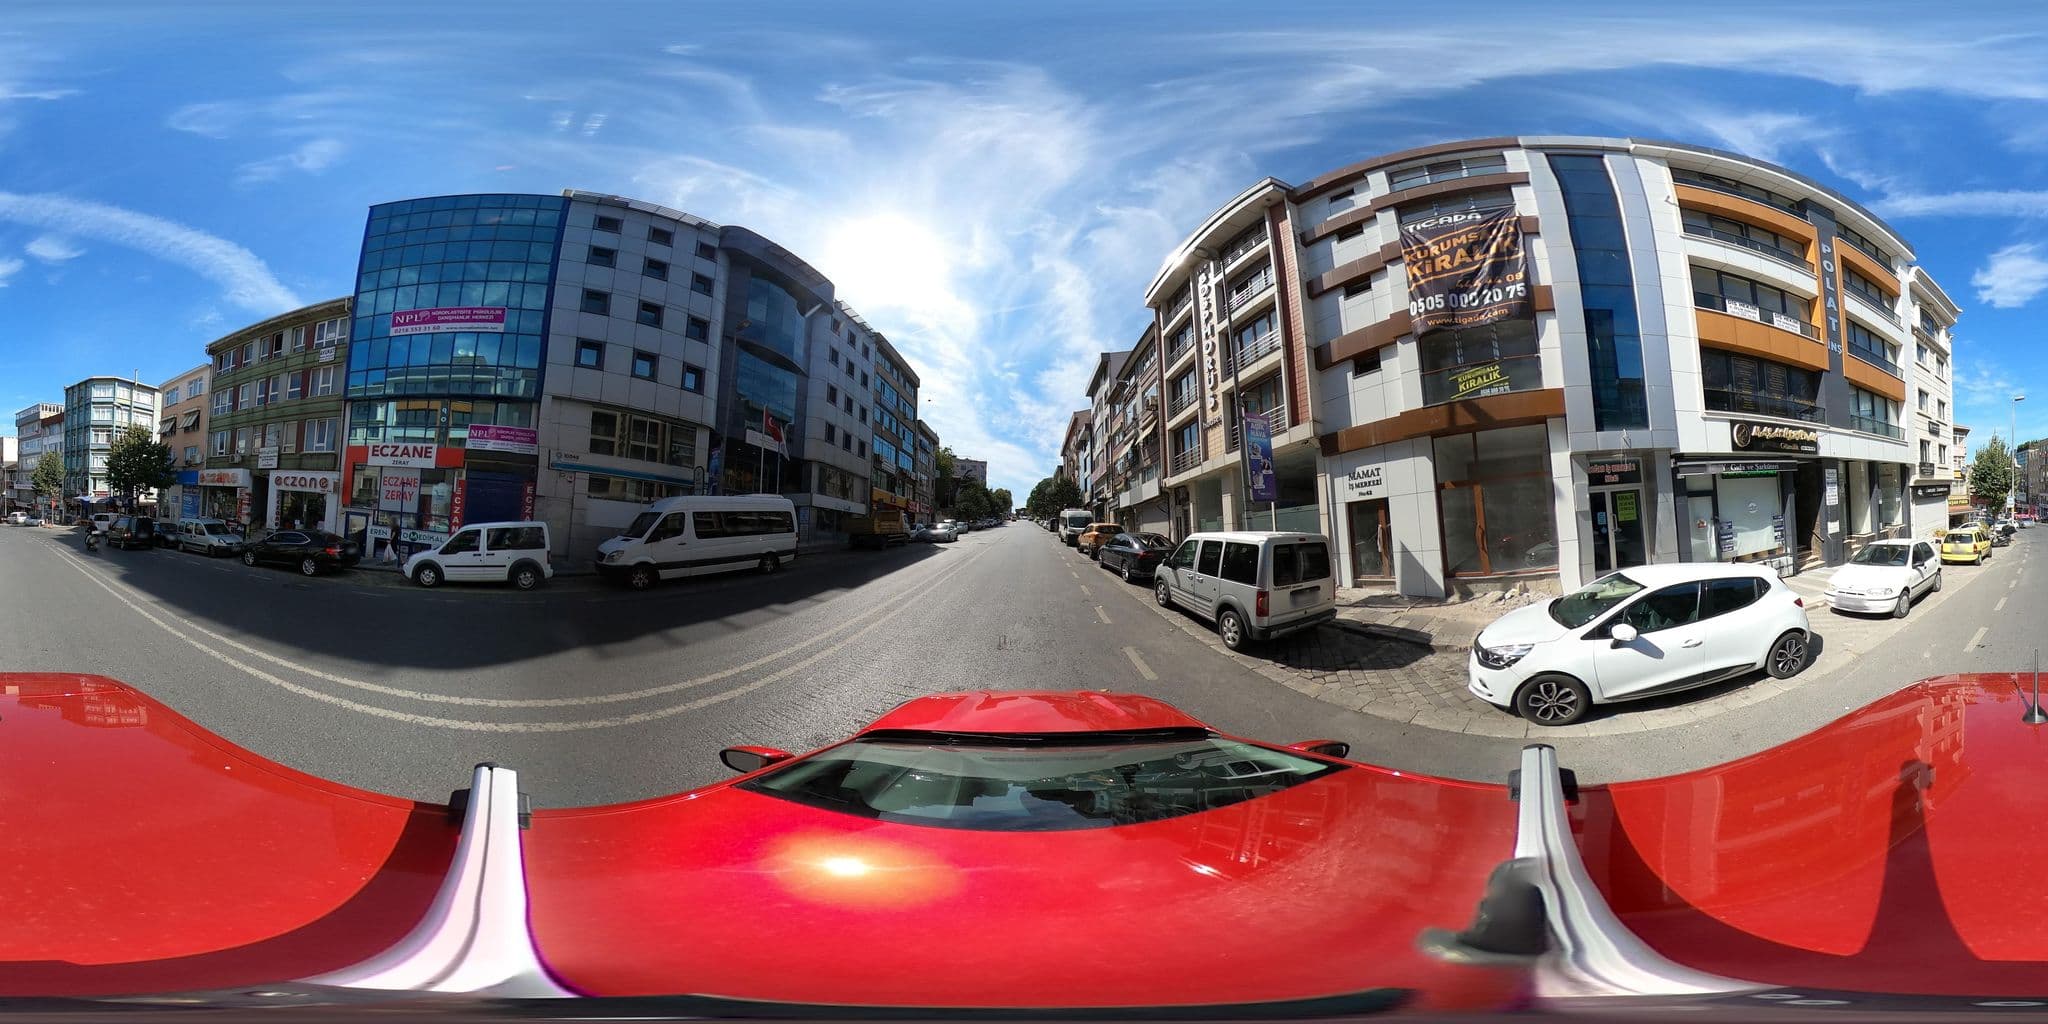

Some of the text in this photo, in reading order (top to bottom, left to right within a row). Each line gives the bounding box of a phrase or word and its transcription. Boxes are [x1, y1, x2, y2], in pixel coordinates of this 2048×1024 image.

[1821, 243, 1838, 332] POLAT
[1409, 294, 1445, 316] 0505
[1505, 283, 1527, 299] 75
[395, 314, 421, 324] NPL
[371, 445, 433, 459] ECZANE
[1348, 467, 1381, 481] MAMAT
[274, 475, 328, 489] eczane
[383, 476, 419, 488] ECZANE
[384, 489, 414, 502] ZERAY
[451, 487, 462, 533] ECZAN
[524, 486, 534, 521] ECZA
[370, 528, 388, 536] EREN
